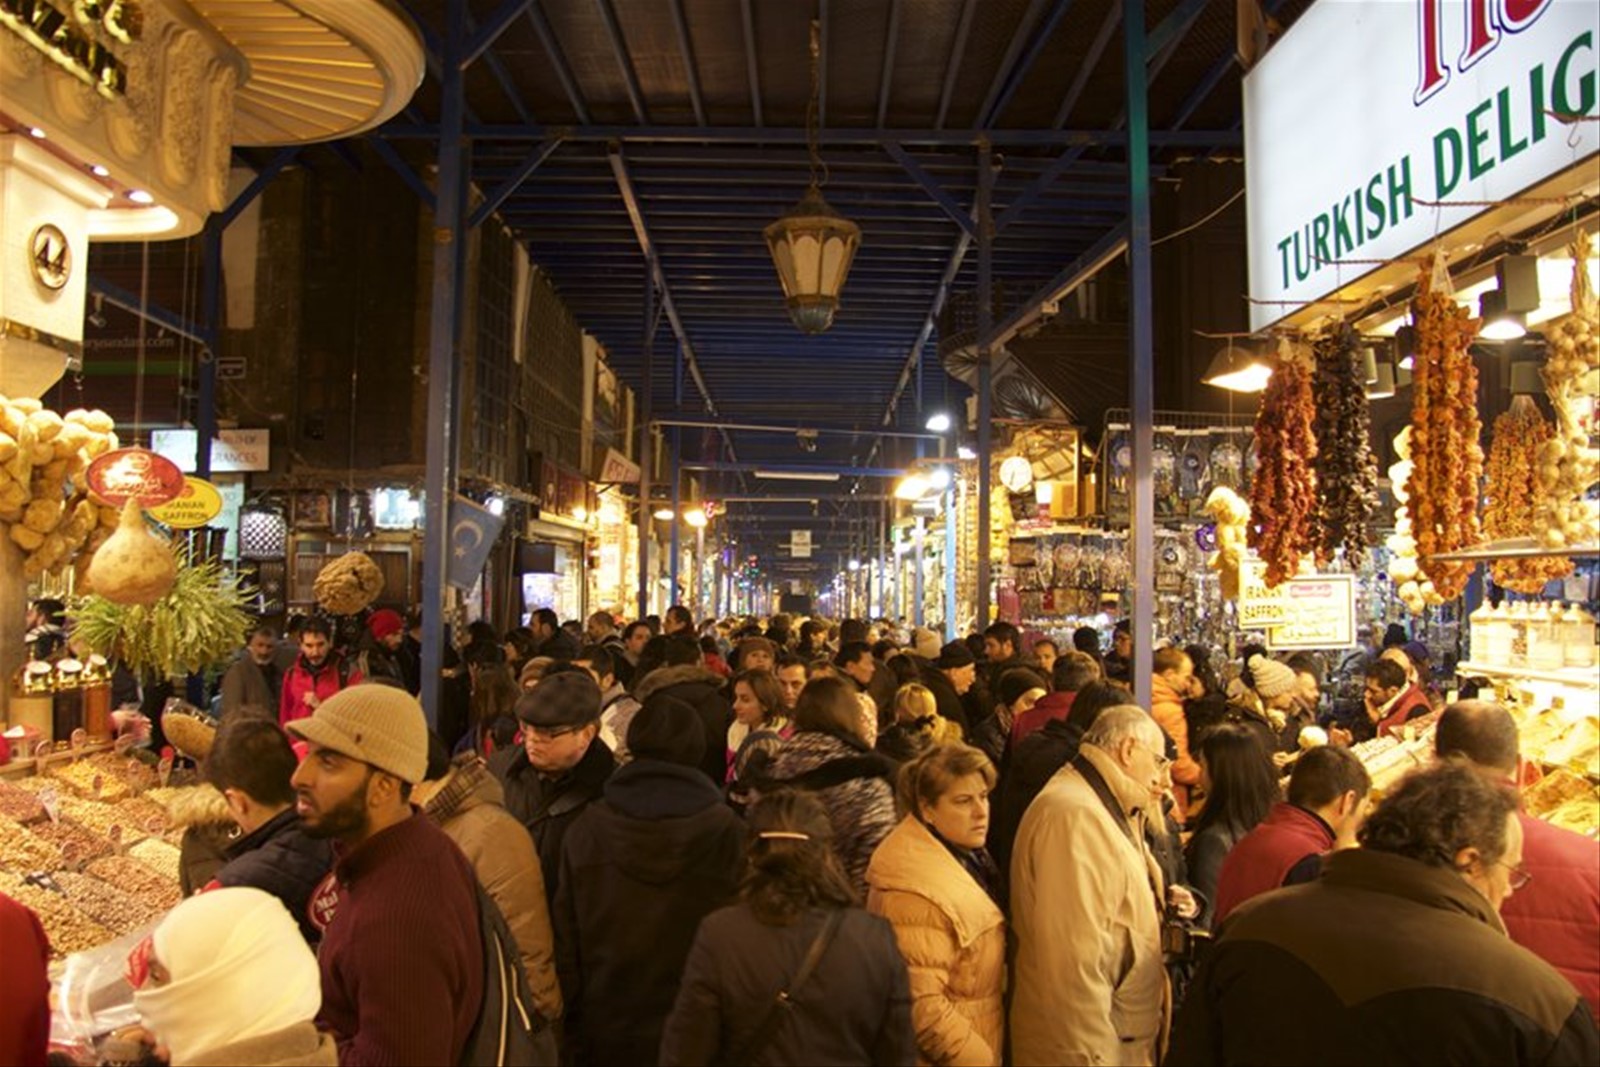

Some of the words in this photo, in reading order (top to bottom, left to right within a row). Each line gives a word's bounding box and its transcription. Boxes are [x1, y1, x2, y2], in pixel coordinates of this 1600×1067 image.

[1277, 154, 1414, 290] TURKISH
[1432, 29, 1596, 200] DELIG
[162, 511, 209, 521] SAFFRON
[1244, 605, 1283, 620] SAFFRON
